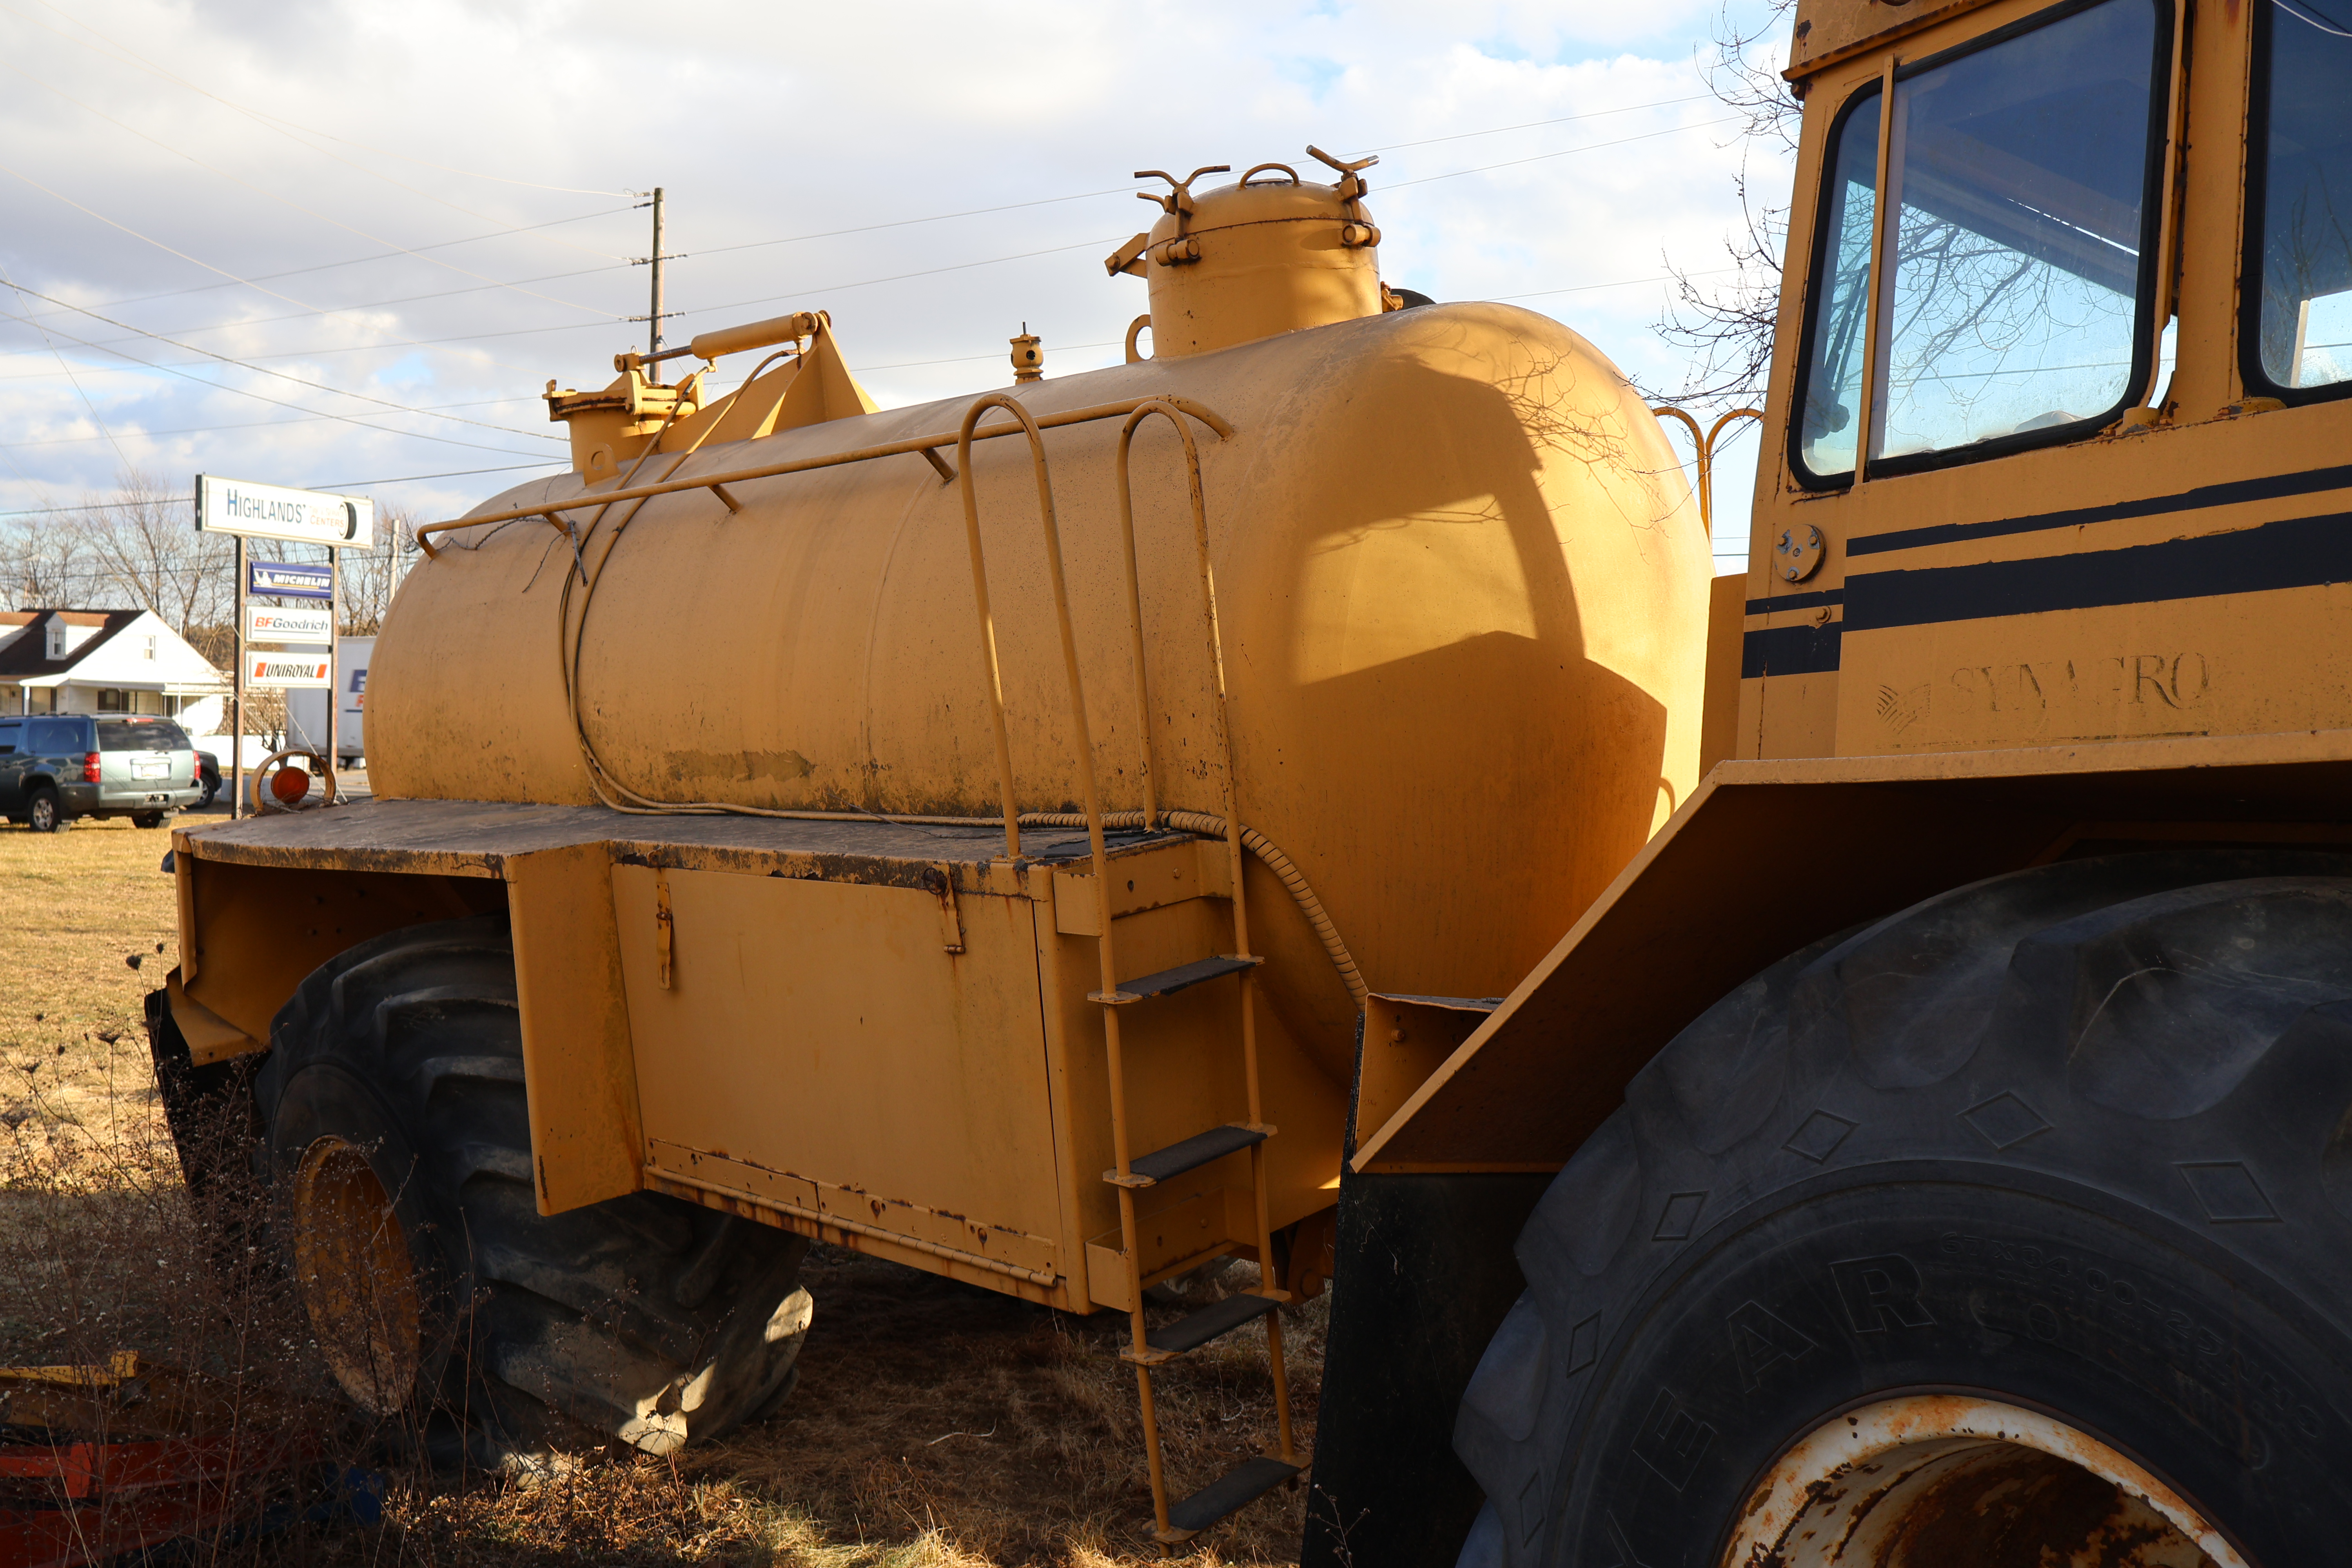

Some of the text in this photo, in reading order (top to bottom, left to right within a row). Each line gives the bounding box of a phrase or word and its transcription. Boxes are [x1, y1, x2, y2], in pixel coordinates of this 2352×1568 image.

[310, 514, 345, 528] CENTERS
[273, 574, 330, 587] MICHELIN
[255, 617, 328, 631] BFGoodrich
[266, 663, 315, 678] UNIROYAL
